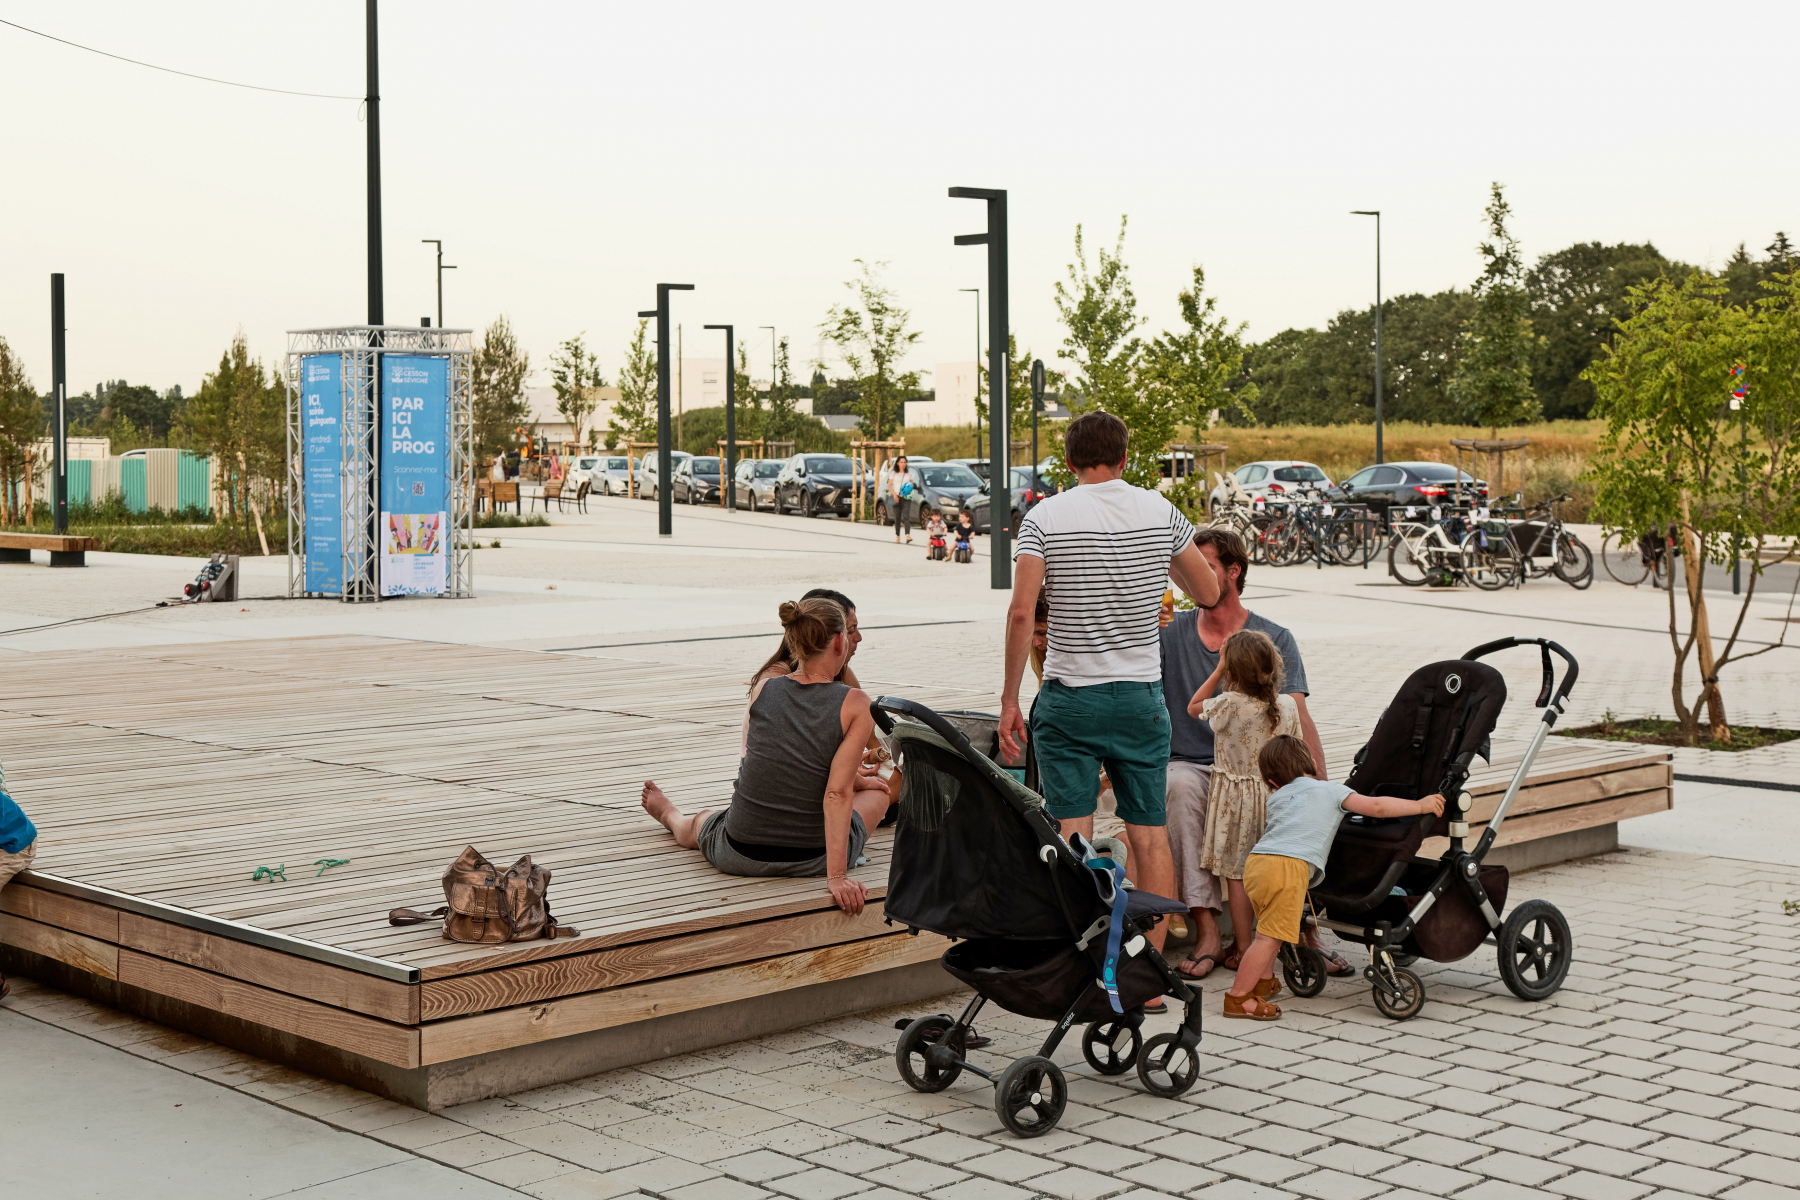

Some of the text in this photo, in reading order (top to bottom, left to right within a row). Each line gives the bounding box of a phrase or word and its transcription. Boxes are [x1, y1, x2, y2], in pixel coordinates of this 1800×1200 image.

[309, 394, 321, 408] ICI,
[392, 397, 424, 410] PAR
[309, 407, 324, 416] soirée
[309, 416, 336, 427] guinguette
[392, 412, 412, 424] ICI
[392, 426, 412, 439] LA
[310, 434, 332, 444] vendredi
[315, 445, 325, 455] juin
[392, 441, 435, 454] PROG
